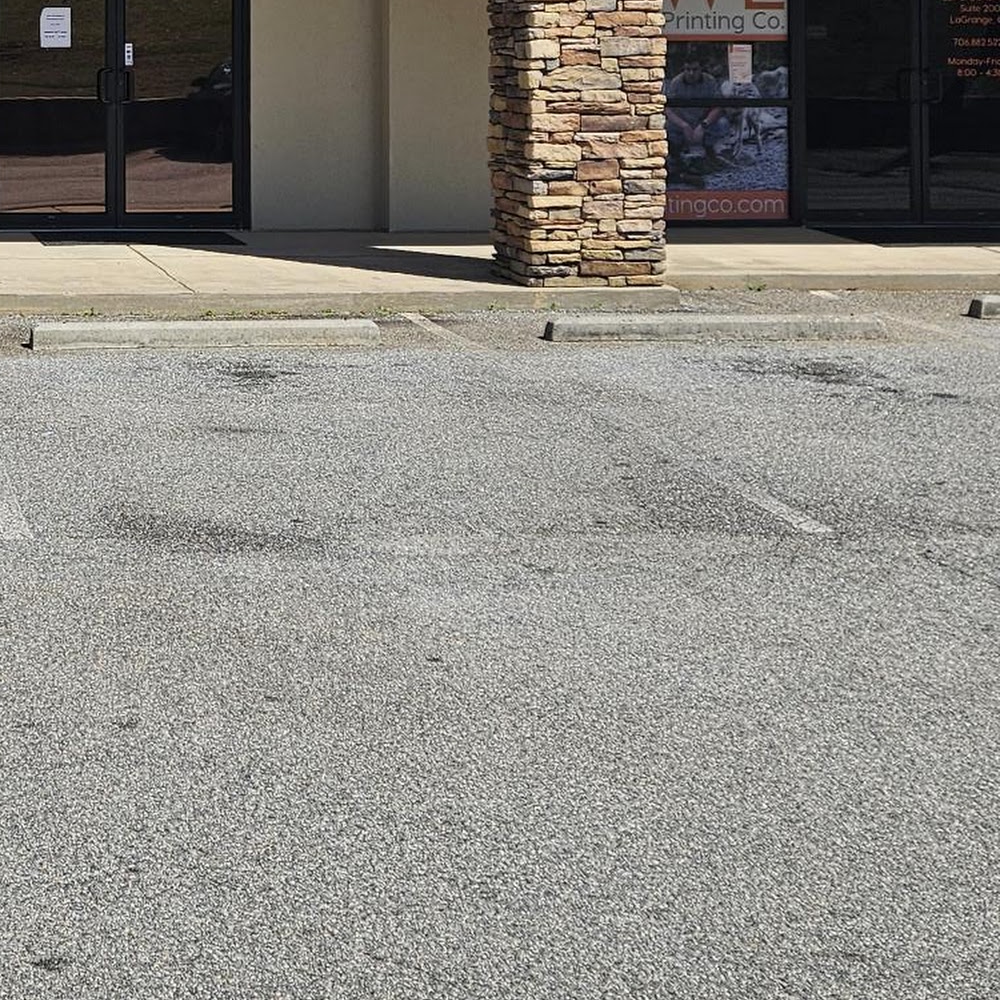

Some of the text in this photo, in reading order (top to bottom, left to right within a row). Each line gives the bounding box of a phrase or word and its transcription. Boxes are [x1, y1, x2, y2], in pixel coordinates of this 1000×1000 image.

[663, 11, 785, 34] Printing Co.
[668, 195, 785, 217] tingco.com
